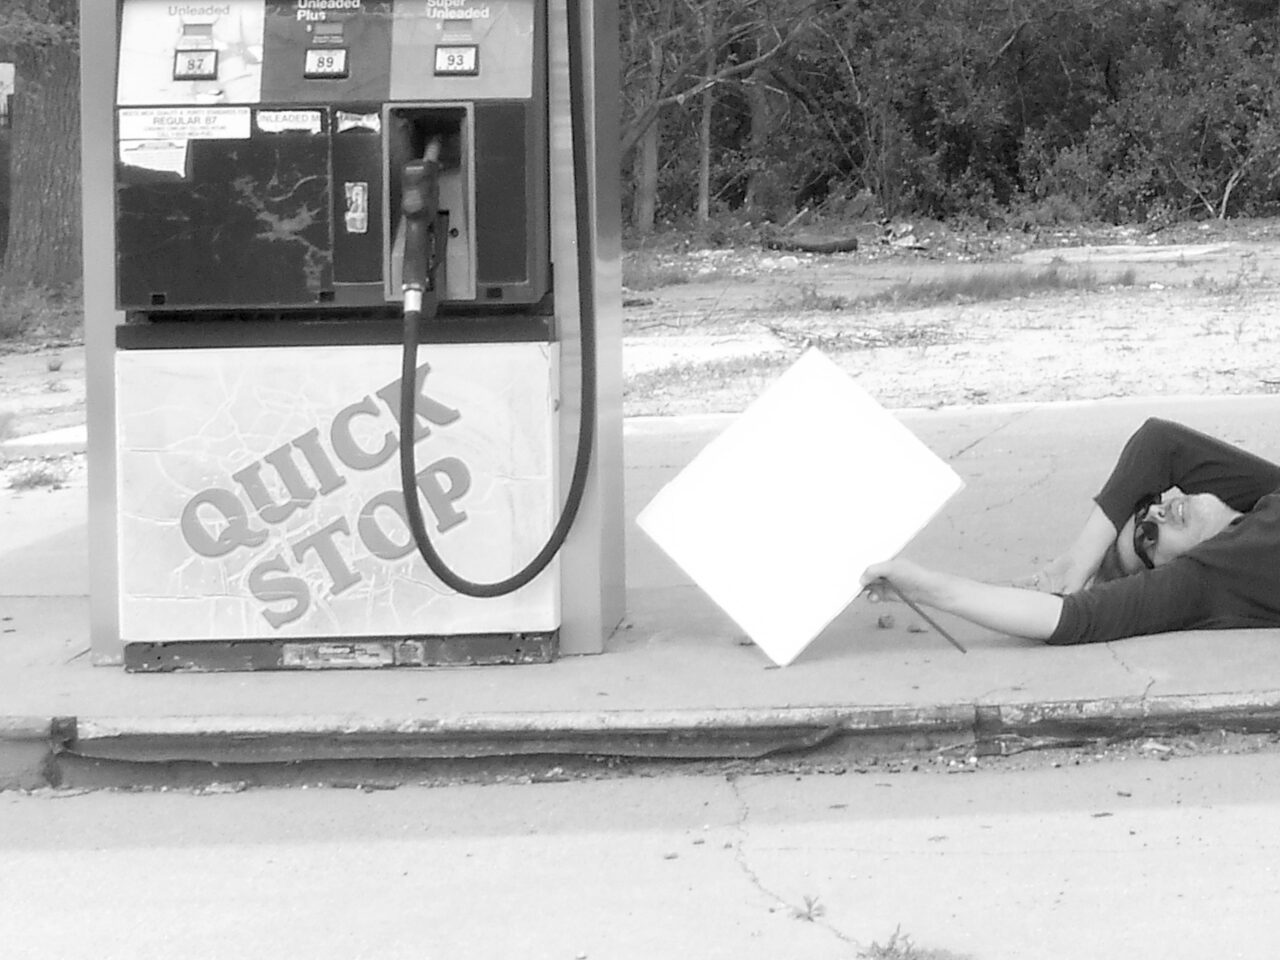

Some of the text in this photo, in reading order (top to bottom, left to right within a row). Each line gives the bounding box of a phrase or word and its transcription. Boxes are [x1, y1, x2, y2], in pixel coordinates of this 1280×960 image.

[168, 4, 230, 16] Unleaded
[297, 9, 326, 21] Plus
[426, 7, 489, 19] Unleaded
[187, 58, 204, 70] 87
[316, 56, 334, 68] 89
[447, 54, 464, 66] 93
[153, 116, 218, 125] REGULAR 87
[180, 362, 461, 558] QUICK
[248, 457, 471, 629] STOP
